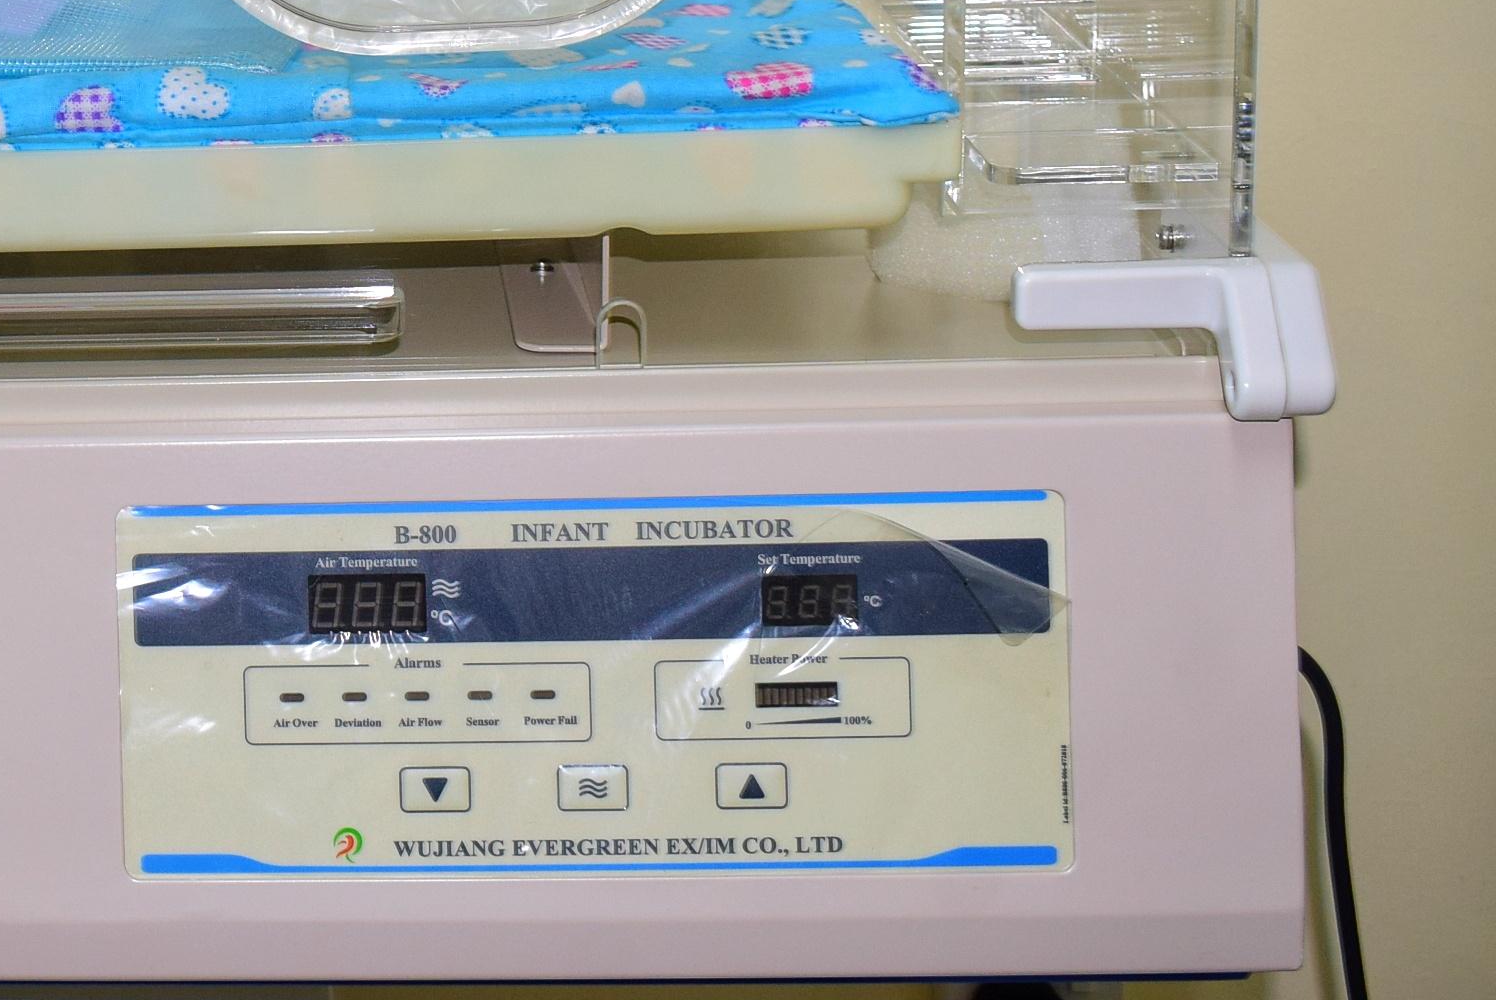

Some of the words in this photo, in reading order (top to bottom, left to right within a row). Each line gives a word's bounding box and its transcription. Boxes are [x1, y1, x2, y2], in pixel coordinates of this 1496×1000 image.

[394, 525, 456, 544] B-800
[511, 522, 609, 542] INFANT
[636, 519, 793, 540] INCUBATOR
[315, 557, 336, 568] Air
[339, 557, 418, 570] Temperature
[757, 553, 776, 564] Set
[780, 553, 861, 566] Temperature
[394, 658, 441, 668] Alarms
[750, 654, 788, 664] Heater
[791, 653, 827, 664] Power
[273, 718, 292, 728] Air
[292, 719, 318, 728] Over
[334, 718, 381, 728] Deviation
[398, 718, 416, 727] Air
[418, 717, 442, 726] Flow
[466, 717, 499, 726] Sensor
[524, 716, 555, 726] Power
[558, 716, 577, 725] Fail
[844, 716, 872, 725] 100%
[394, 840, 504, 857] WUJIANG
[512, 837, 660, 857] EVERGREEN
[666, 837, 735, 855] EX/IM
[742, 837, 789, 855] CO.,
[795, 836, 843, 853] LTD
